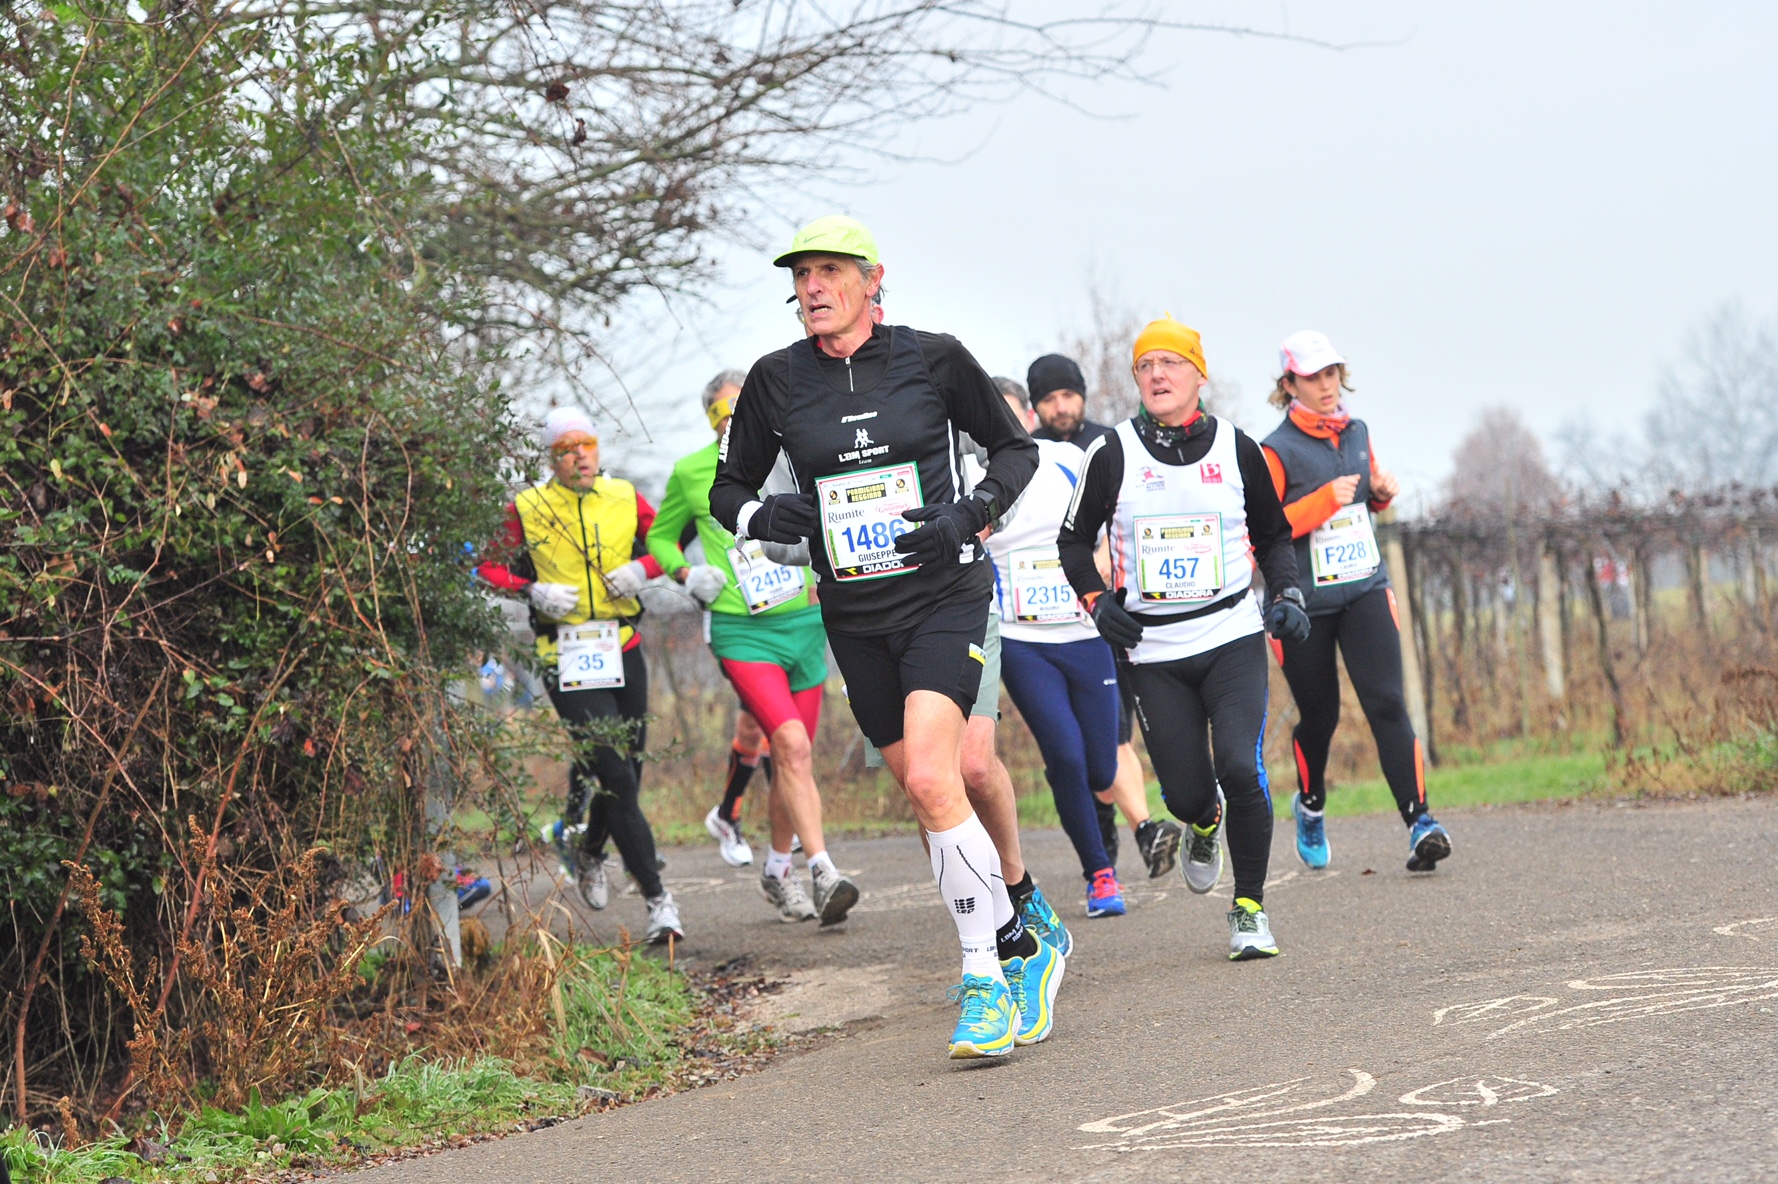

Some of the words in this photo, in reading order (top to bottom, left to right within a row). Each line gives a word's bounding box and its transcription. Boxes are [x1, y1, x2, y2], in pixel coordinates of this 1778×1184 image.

[861, 445, 890, 458] SPORT
[846, 483, 886, 497] PARMIGIANO
[850, 491, 883, 503] REGGIANO
[827, 508, 865, 524] Riunite
[841, 518, 908, 553] 1486
[858, 548, 898, 563] GIUSEPPE
[1141, 544, 1175, 556] Riunite
[1325, 541, 1367, 565] F228
[1158, 557, 1200, 580] 457
[751, 565, 792, 593] 2415
[1165, 581, 1196, 590] CLAUDIO
[1026, 584, 1071, 605] 2315
[1165, 589, 1215, 600] DIADORA
[578, 653, 605, 672] 35
